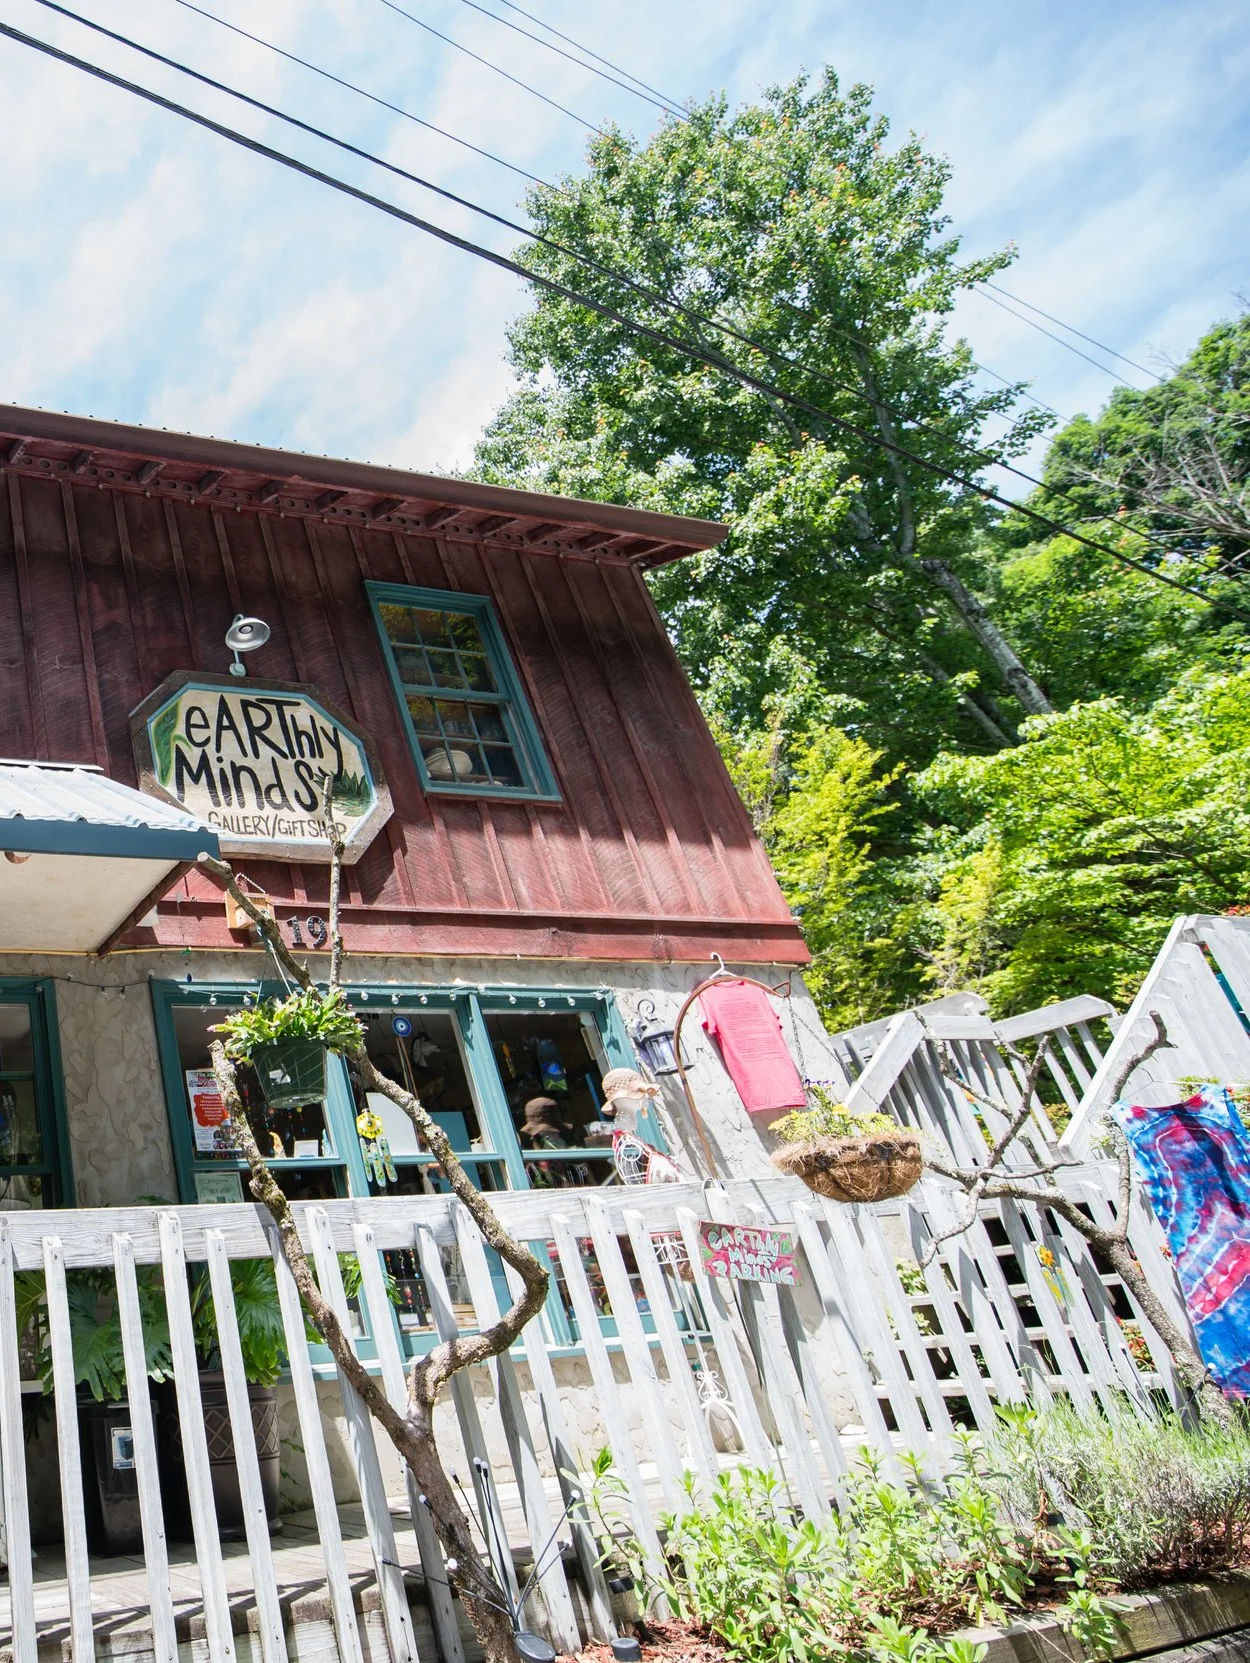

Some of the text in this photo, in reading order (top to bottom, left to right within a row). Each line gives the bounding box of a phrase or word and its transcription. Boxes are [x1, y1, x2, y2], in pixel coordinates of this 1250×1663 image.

[185, 694, 342, 778] eARThly
[174, 744, 320, 812] Minds
[286, 915, 327, 948] 19
[708, 1227, 779, 1262] eARThly
[711, 1260, 795, 1285] PARKING
